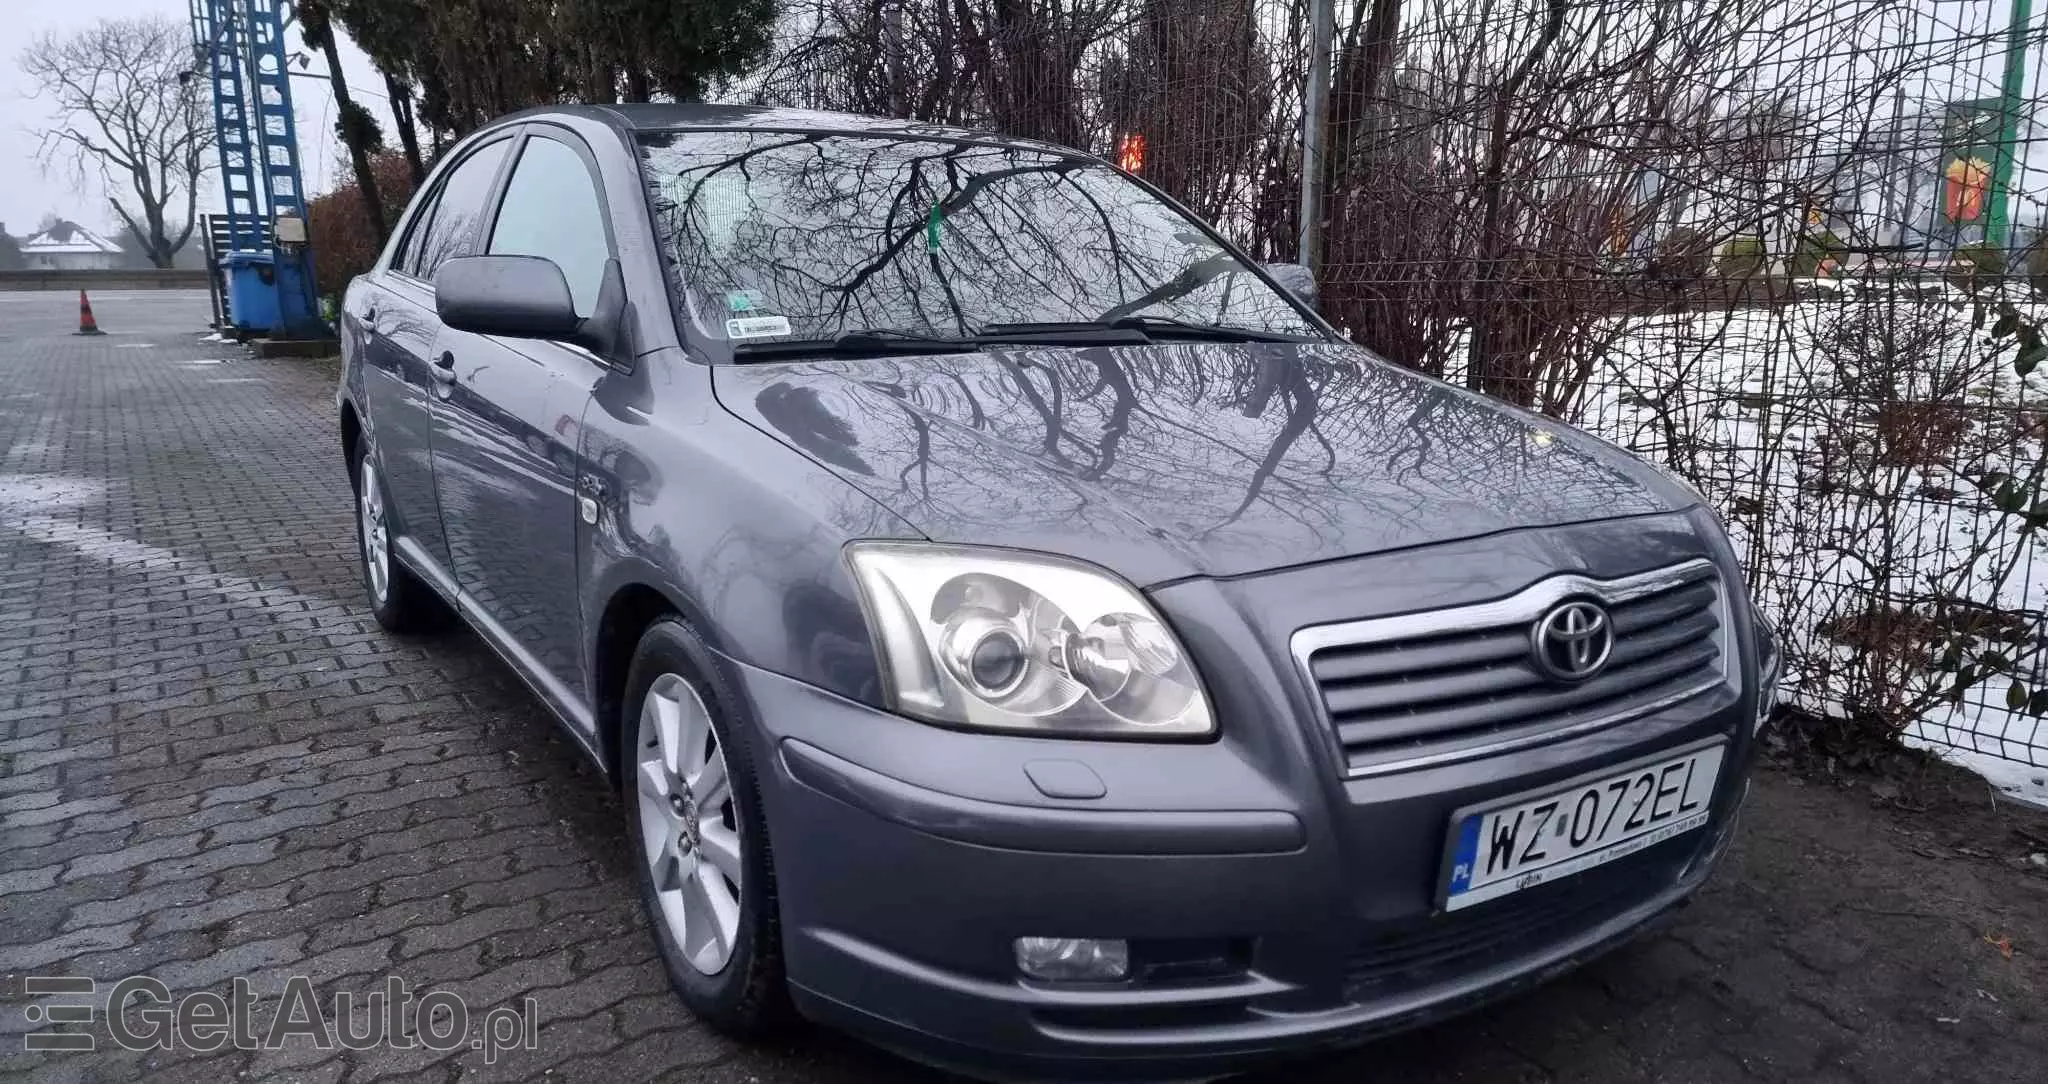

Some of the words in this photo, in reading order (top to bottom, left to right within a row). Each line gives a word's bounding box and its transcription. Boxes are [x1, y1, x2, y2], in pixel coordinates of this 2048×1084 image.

[1486, 800, 1560, 875] WZ
[1570, 758, 1698, 848] 072EL
[1451, 862, 1470, 883] PL
